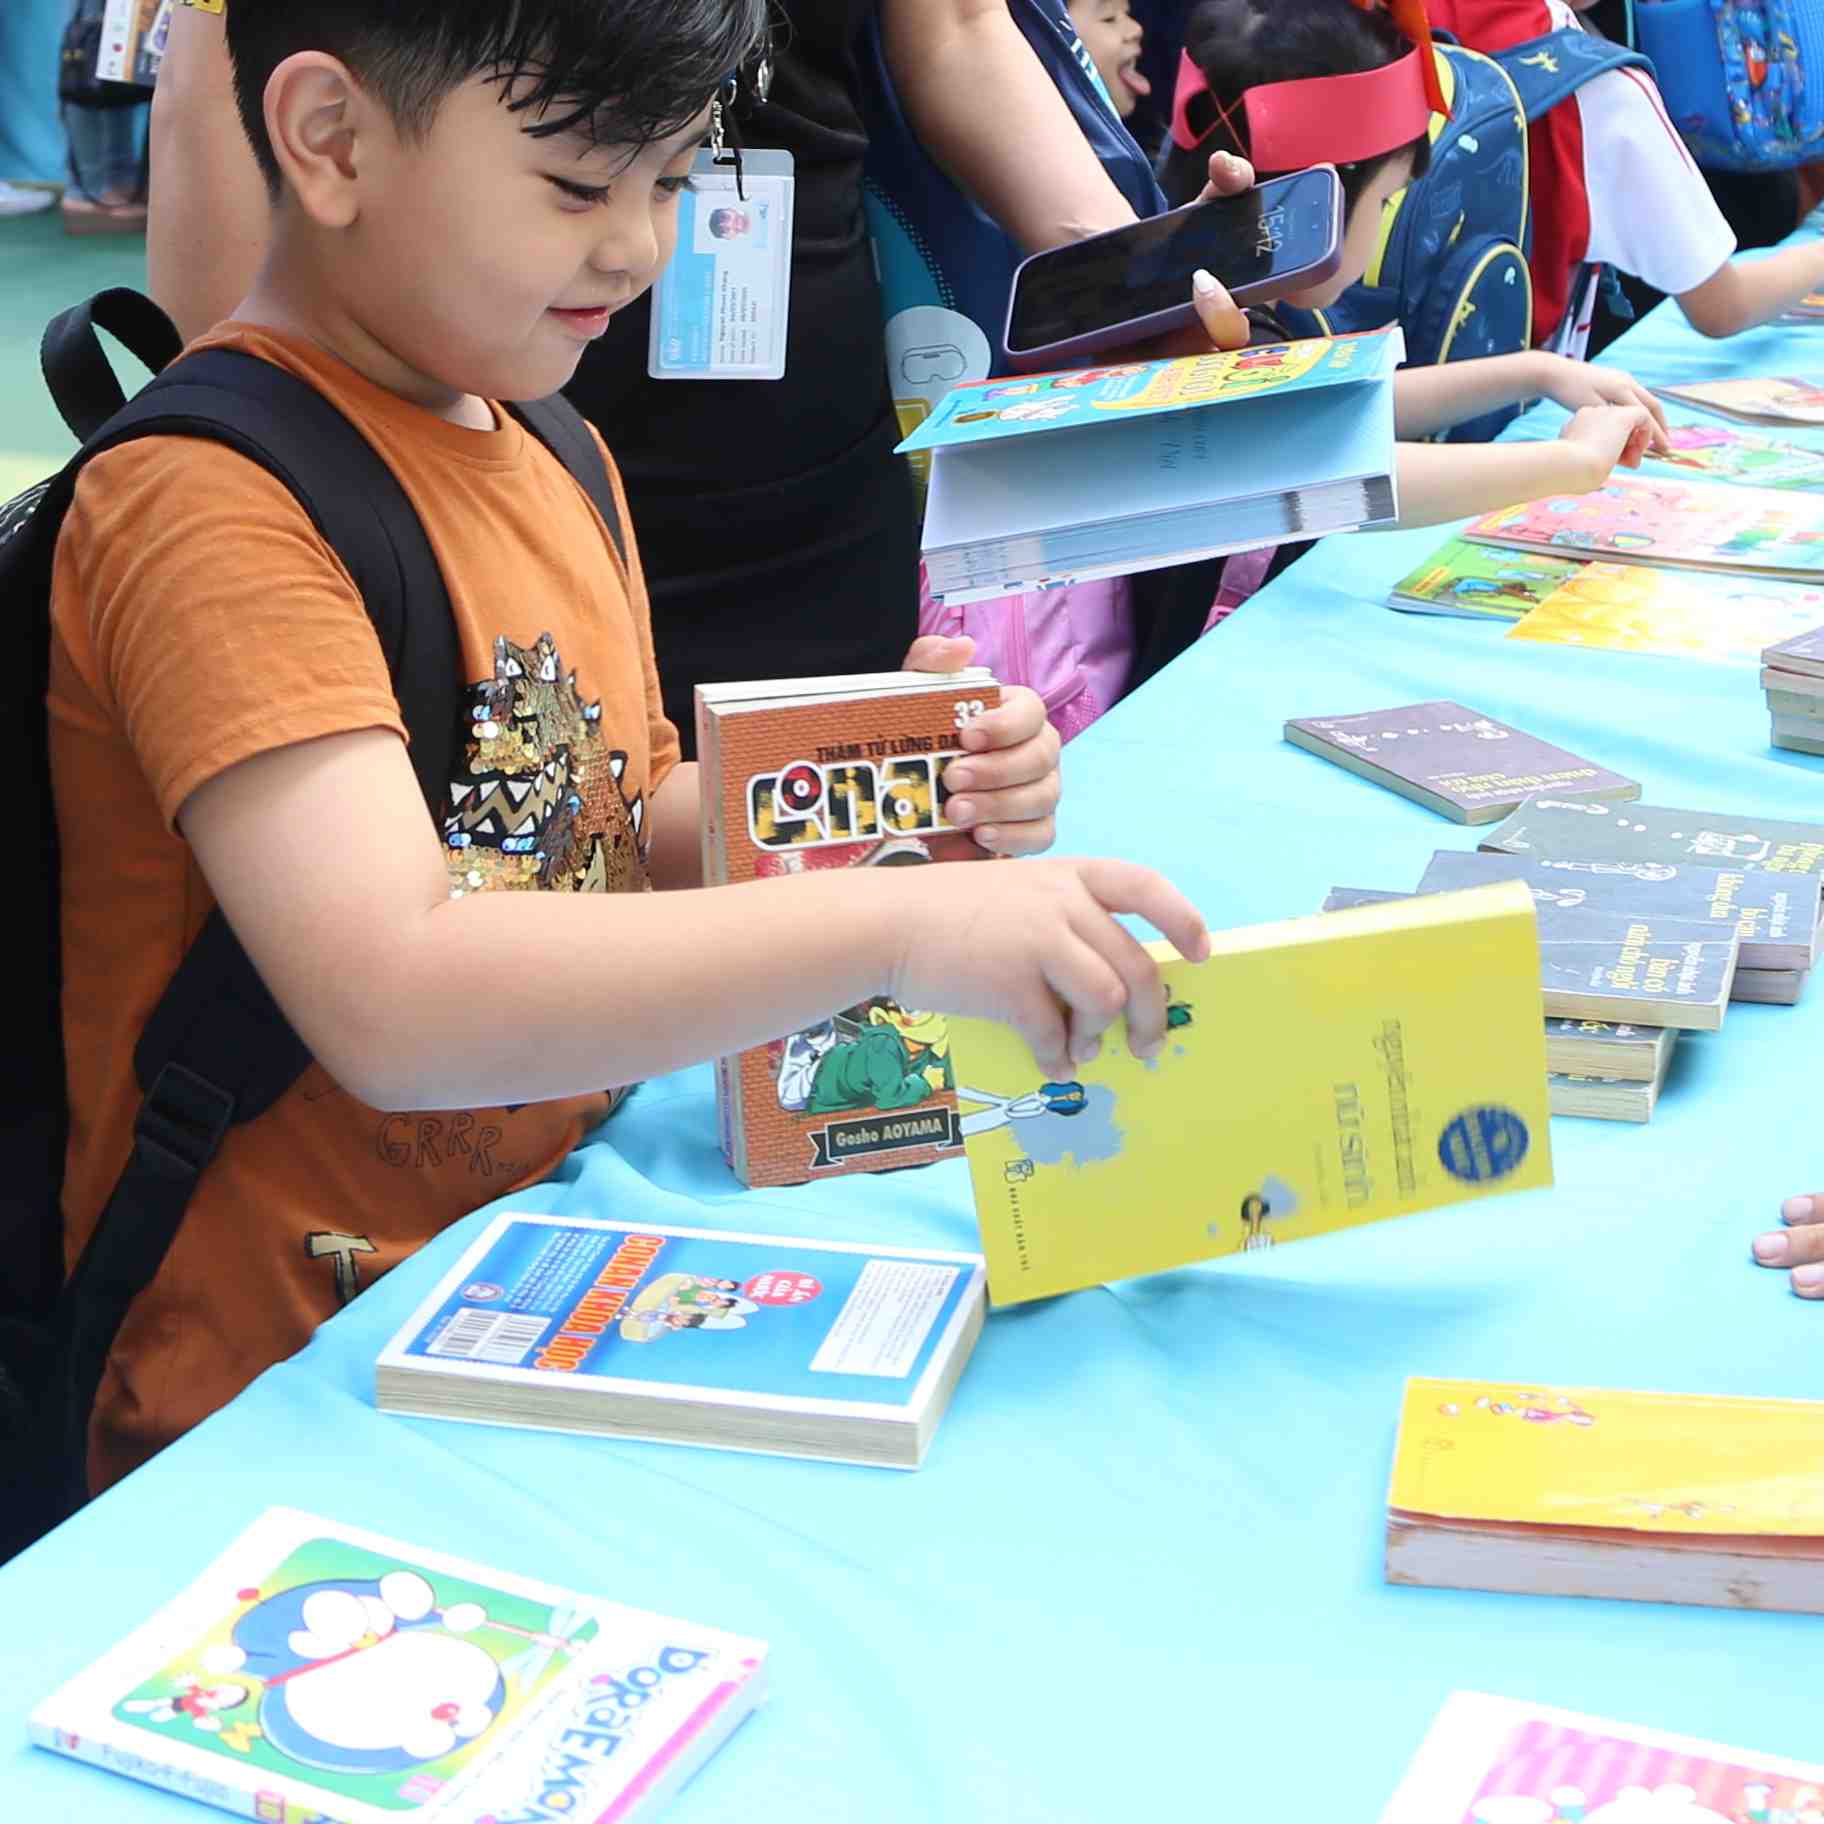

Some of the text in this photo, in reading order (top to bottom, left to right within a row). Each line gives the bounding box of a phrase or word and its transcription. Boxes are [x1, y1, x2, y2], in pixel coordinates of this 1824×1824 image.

[1254, 205, 1285, 258] 15:12
[953, 700, 986, 731] 33
[816, 741, 868, 763] THÁM
[889, 735, 934, 756] LỪNG
[938, 732, 964, 752] DA
[1621, 922, 1655, 947] năm
[1640, 956, 1679, 993] bàn có
[835, 1118, 944, 1149] Gosho AOYAMA
[597, 1234, 666, 1291] CONAN
[561, 1286, 629, 1335] KHOA
[533, 1331, 597, 1372] HỌC
